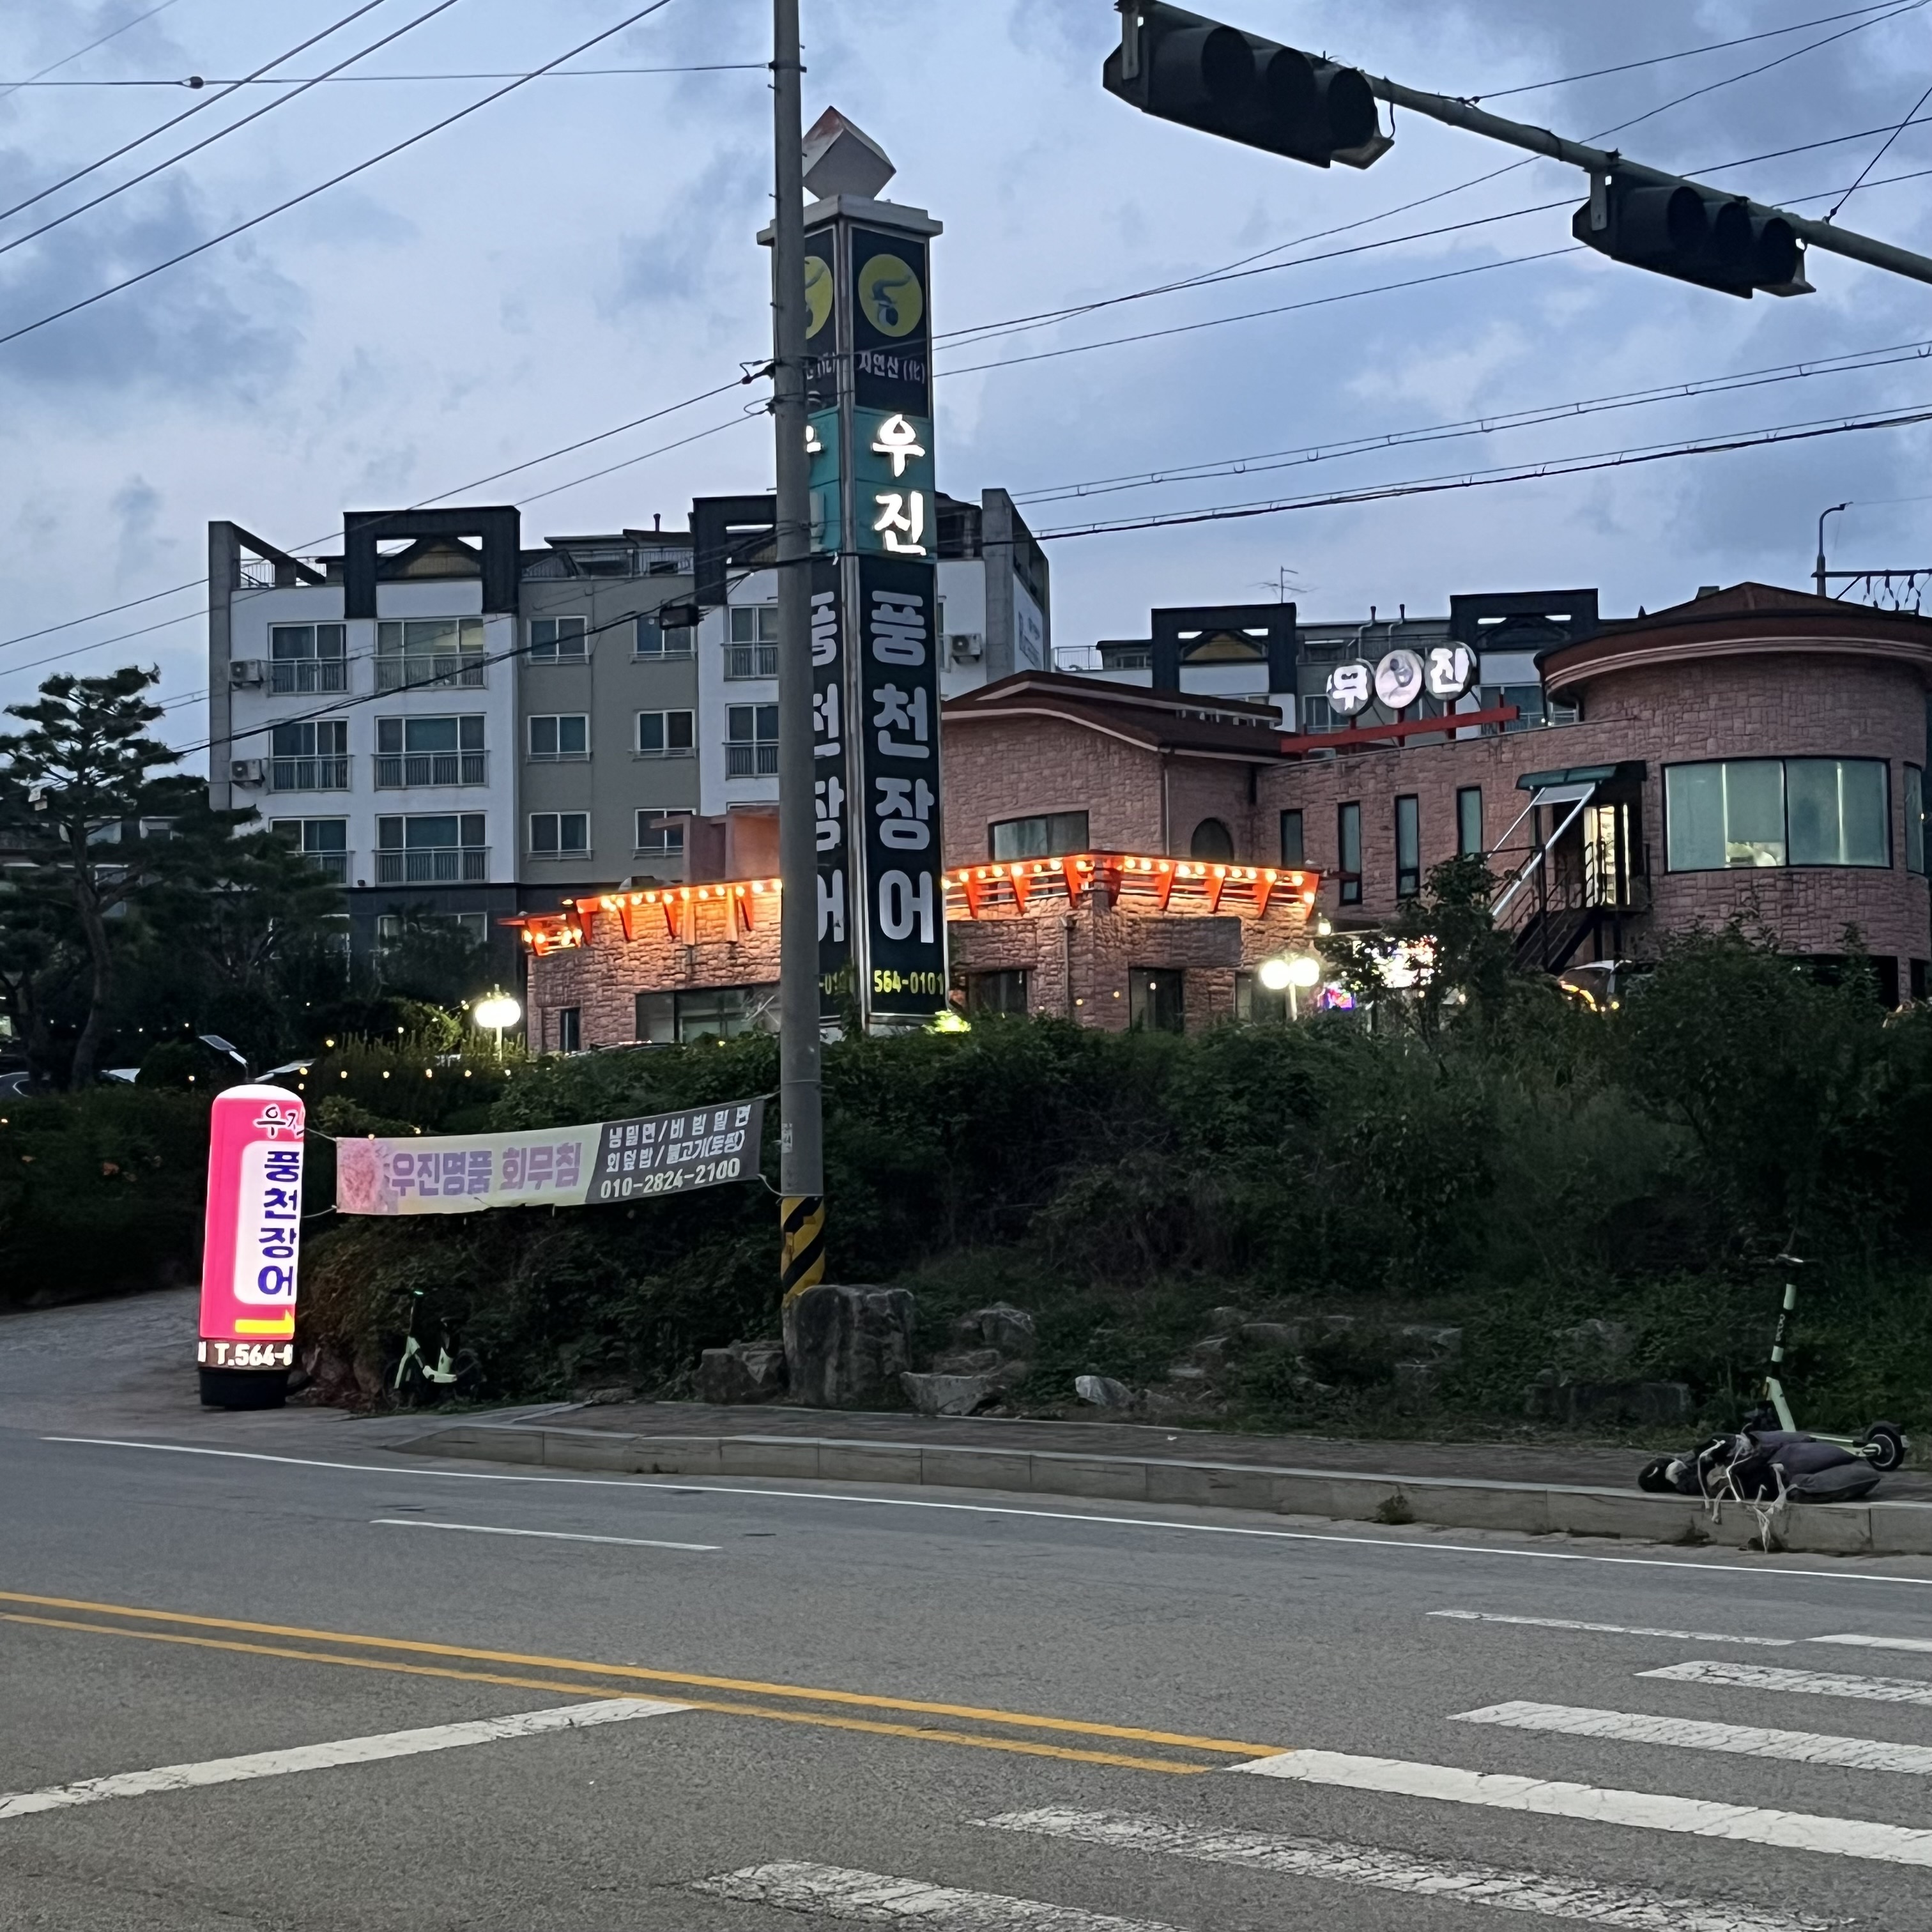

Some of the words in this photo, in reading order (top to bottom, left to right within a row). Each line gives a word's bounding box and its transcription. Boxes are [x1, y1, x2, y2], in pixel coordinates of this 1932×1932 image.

[871, 413, 926, 556] 우진
[870, 589, 935, 944] 풍천장어
[873, 969, 944, 995] 564-0101
[391, 1150, 493, 1197] 우진명품
[500, 1142, 583, 1190] 회무침
[600, 1157, 741, 1199] 010-2824-2100
[257, 1150, 300, 1298] 풍천장어
